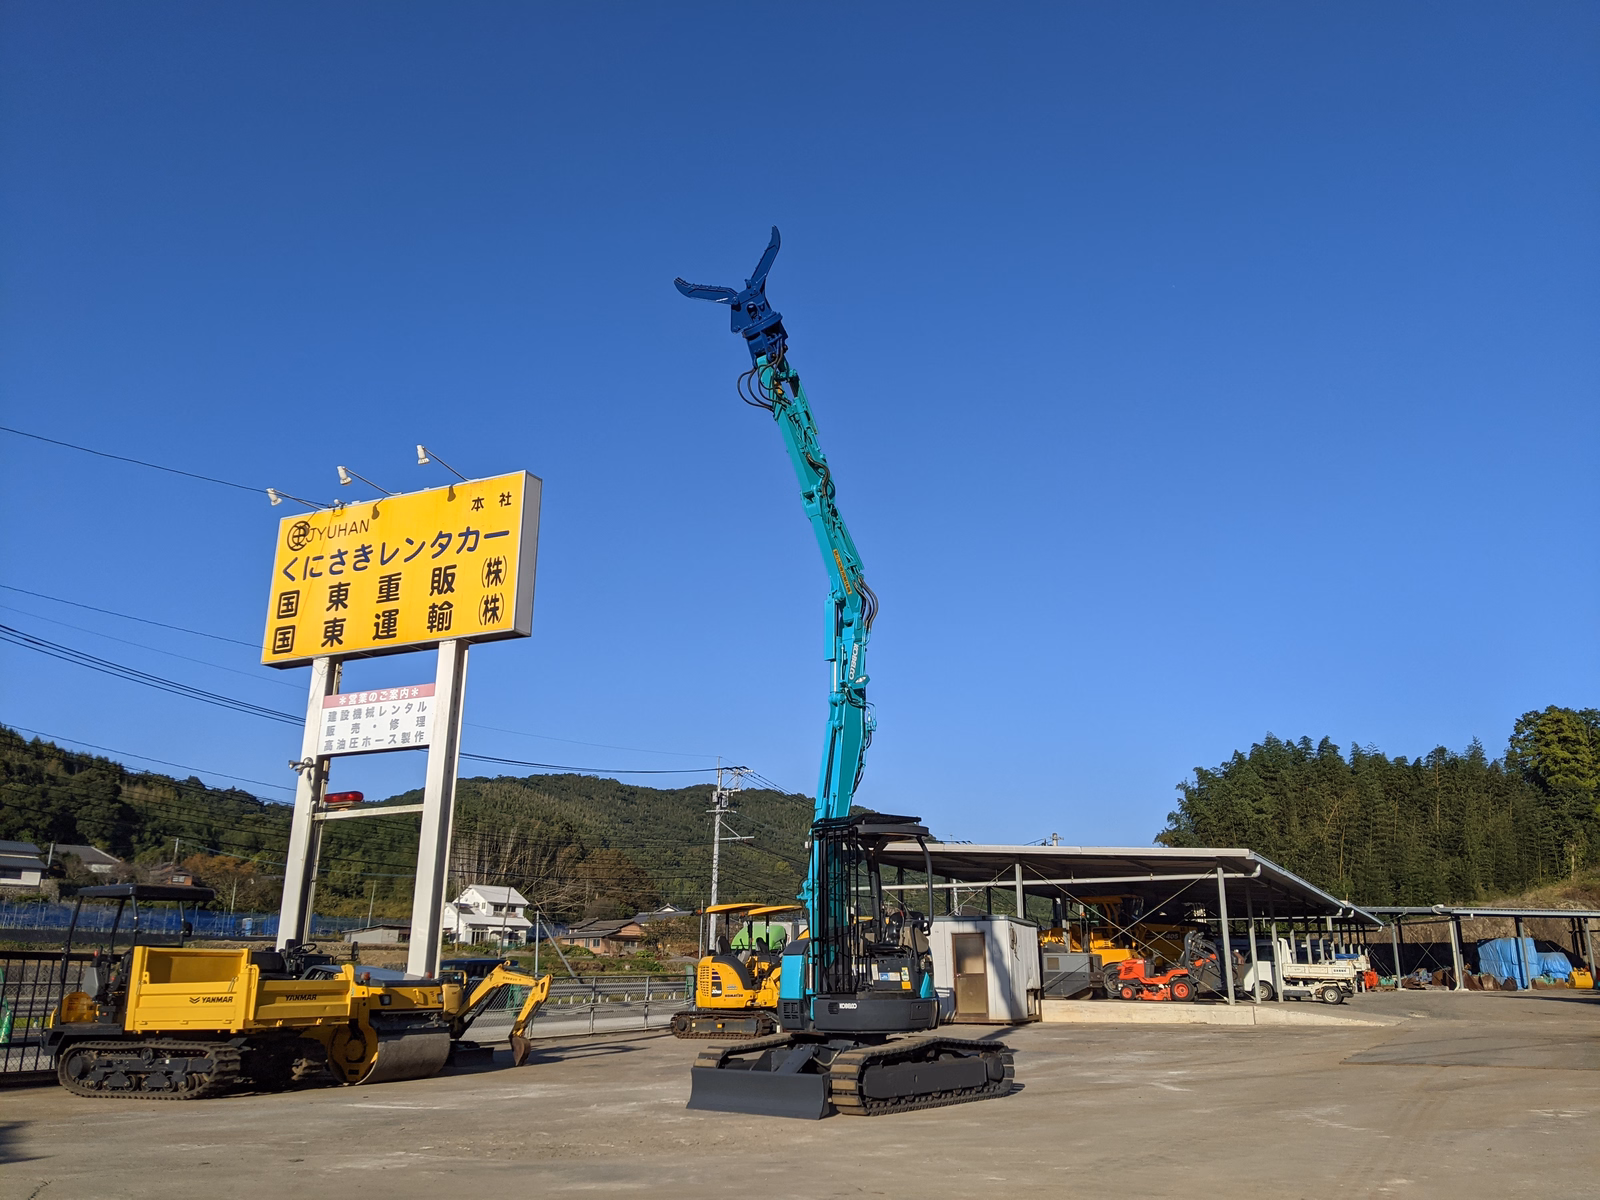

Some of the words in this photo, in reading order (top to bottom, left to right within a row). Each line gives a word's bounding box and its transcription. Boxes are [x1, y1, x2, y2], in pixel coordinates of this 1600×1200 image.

[471, 491, 512, 512] 本社
[305, 518, 370, 543] JYUHAN
[282, 526, 510, 582] くにさきレンタカー
[327, 701, 428, 723] 建設機械レンタル
[323, 730, 425, 752] 高油圧ホース製作
[201, 996, 234, 1004] YANMAR
[285, 994, 318, 1002] YANMAR
